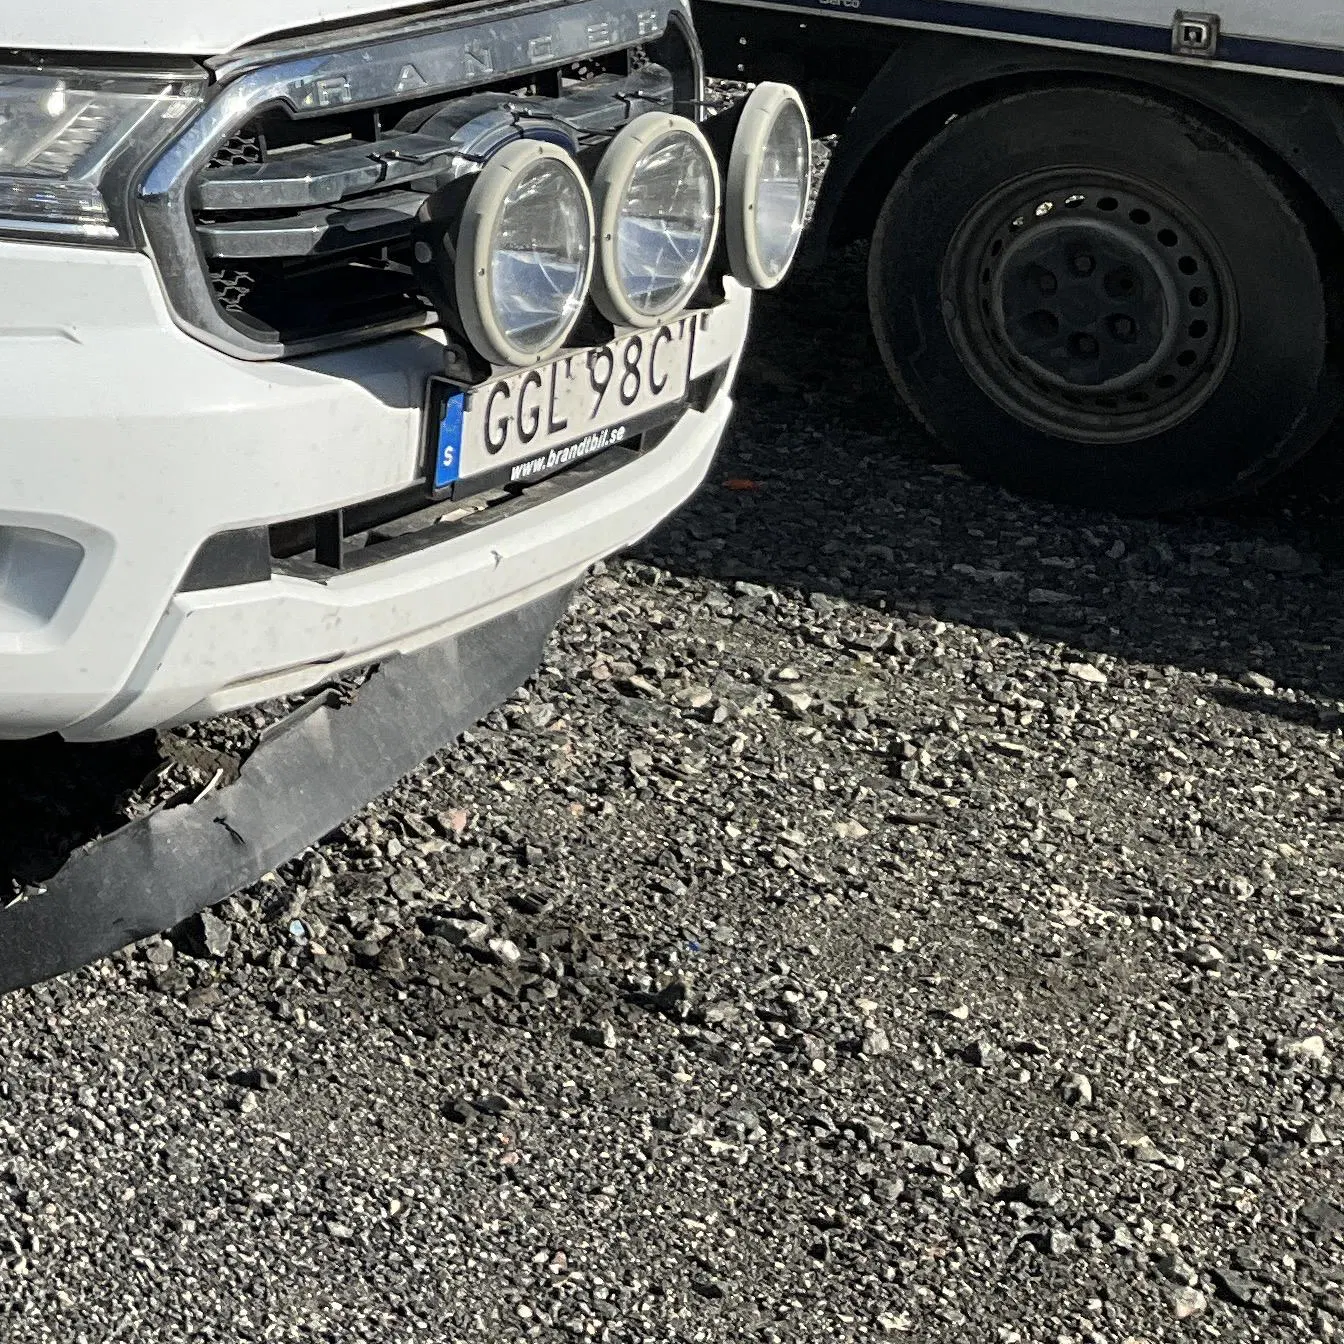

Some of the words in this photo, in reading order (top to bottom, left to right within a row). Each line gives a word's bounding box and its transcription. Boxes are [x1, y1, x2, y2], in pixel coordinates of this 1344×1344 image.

[314, 8, 658, 106] RANGER
[484, 360, 568, 455] GGL
[443, 445, 454, 467] S
[510, 424, 626, 482] www.brandtbil.se
